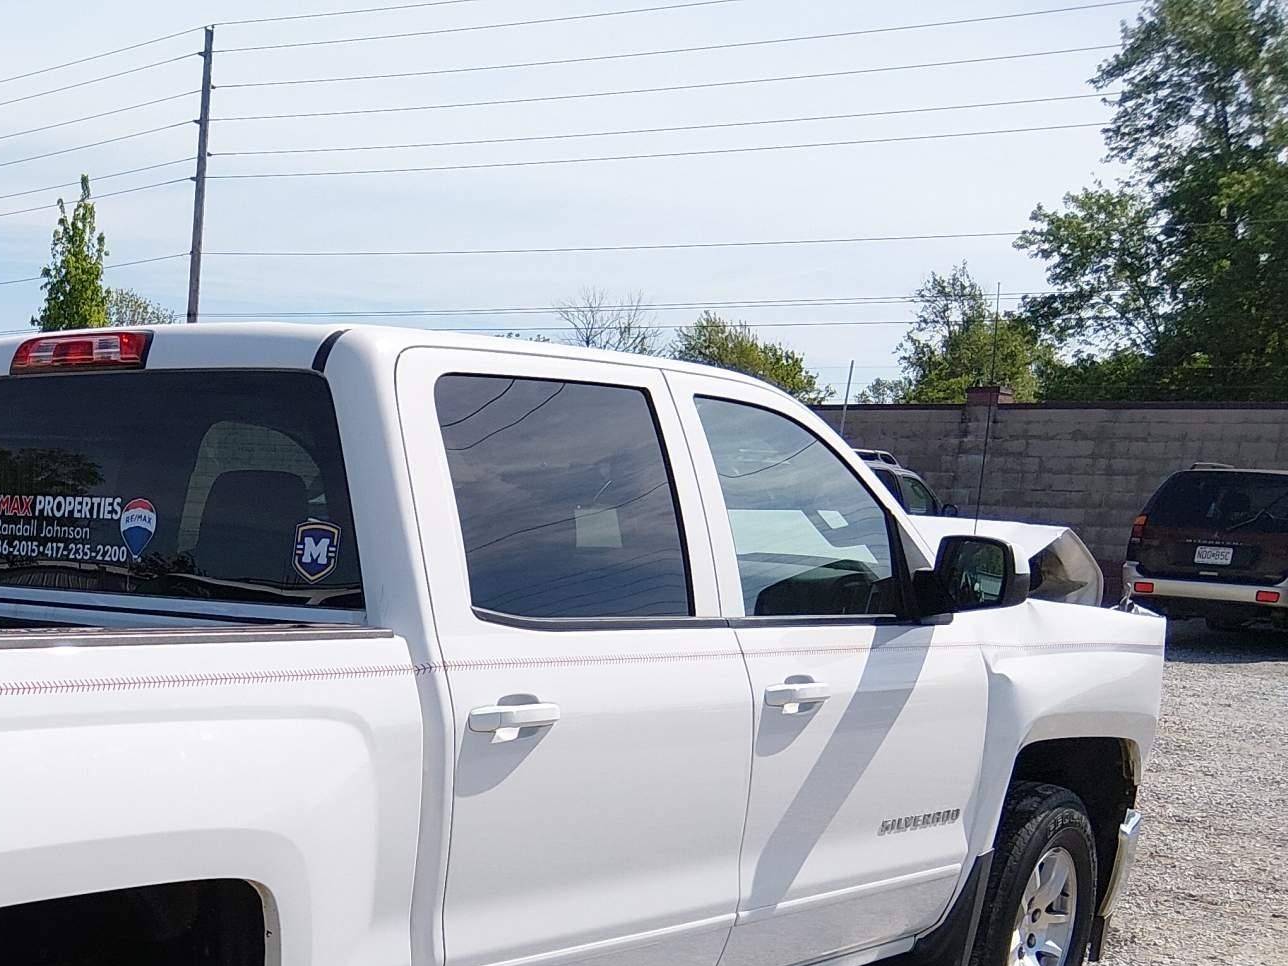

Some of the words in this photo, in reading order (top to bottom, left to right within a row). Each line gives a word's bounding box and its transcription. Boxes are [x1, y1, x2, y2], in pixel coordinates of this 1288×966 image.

[35, 495, 122, 520] PROPERTIES
[125, 513, 152, 525] RE/MAX
[40, 521, 90, 540] Johnson
[879, 808, 961, 835] SILVERADO
